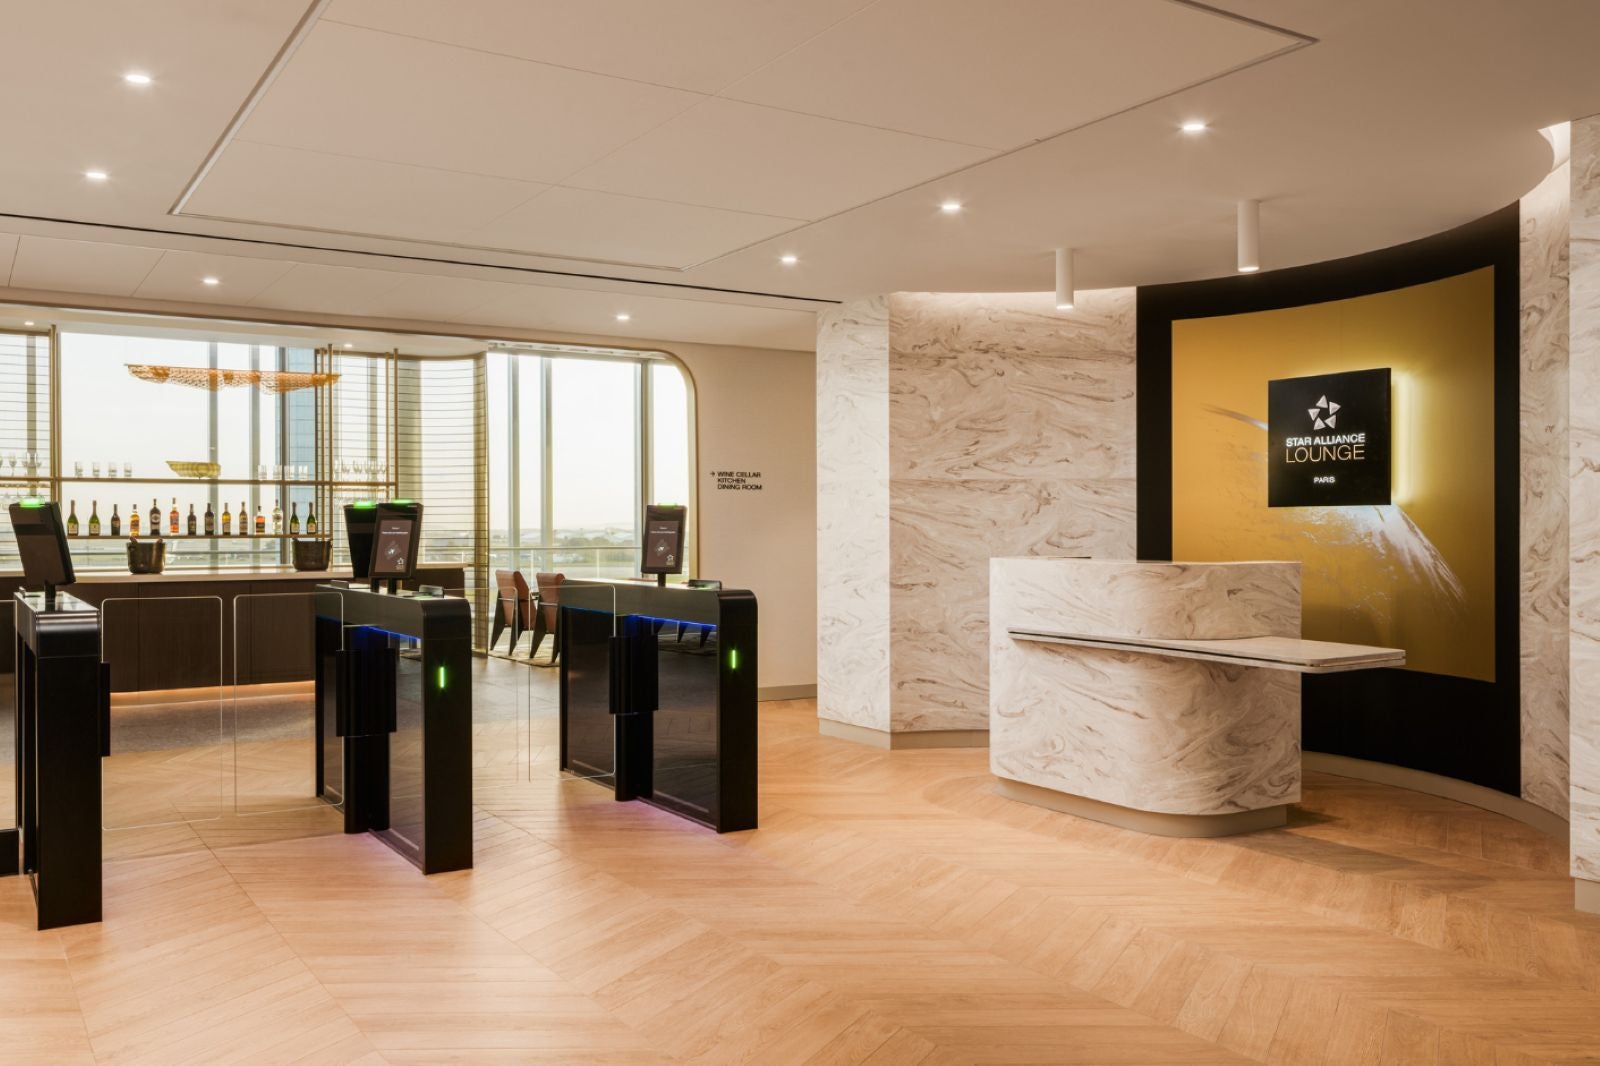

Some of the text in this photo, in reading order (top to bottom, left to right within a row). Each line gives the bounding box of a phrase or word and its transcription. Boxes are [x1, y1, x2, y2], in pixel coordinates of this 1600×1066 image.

[1286, 433, 1366, 447] STAR ALLIANCE
[1285, 444, 1365, 463] LOUNGE
[1313, 476, 1336, 484] PARIS
